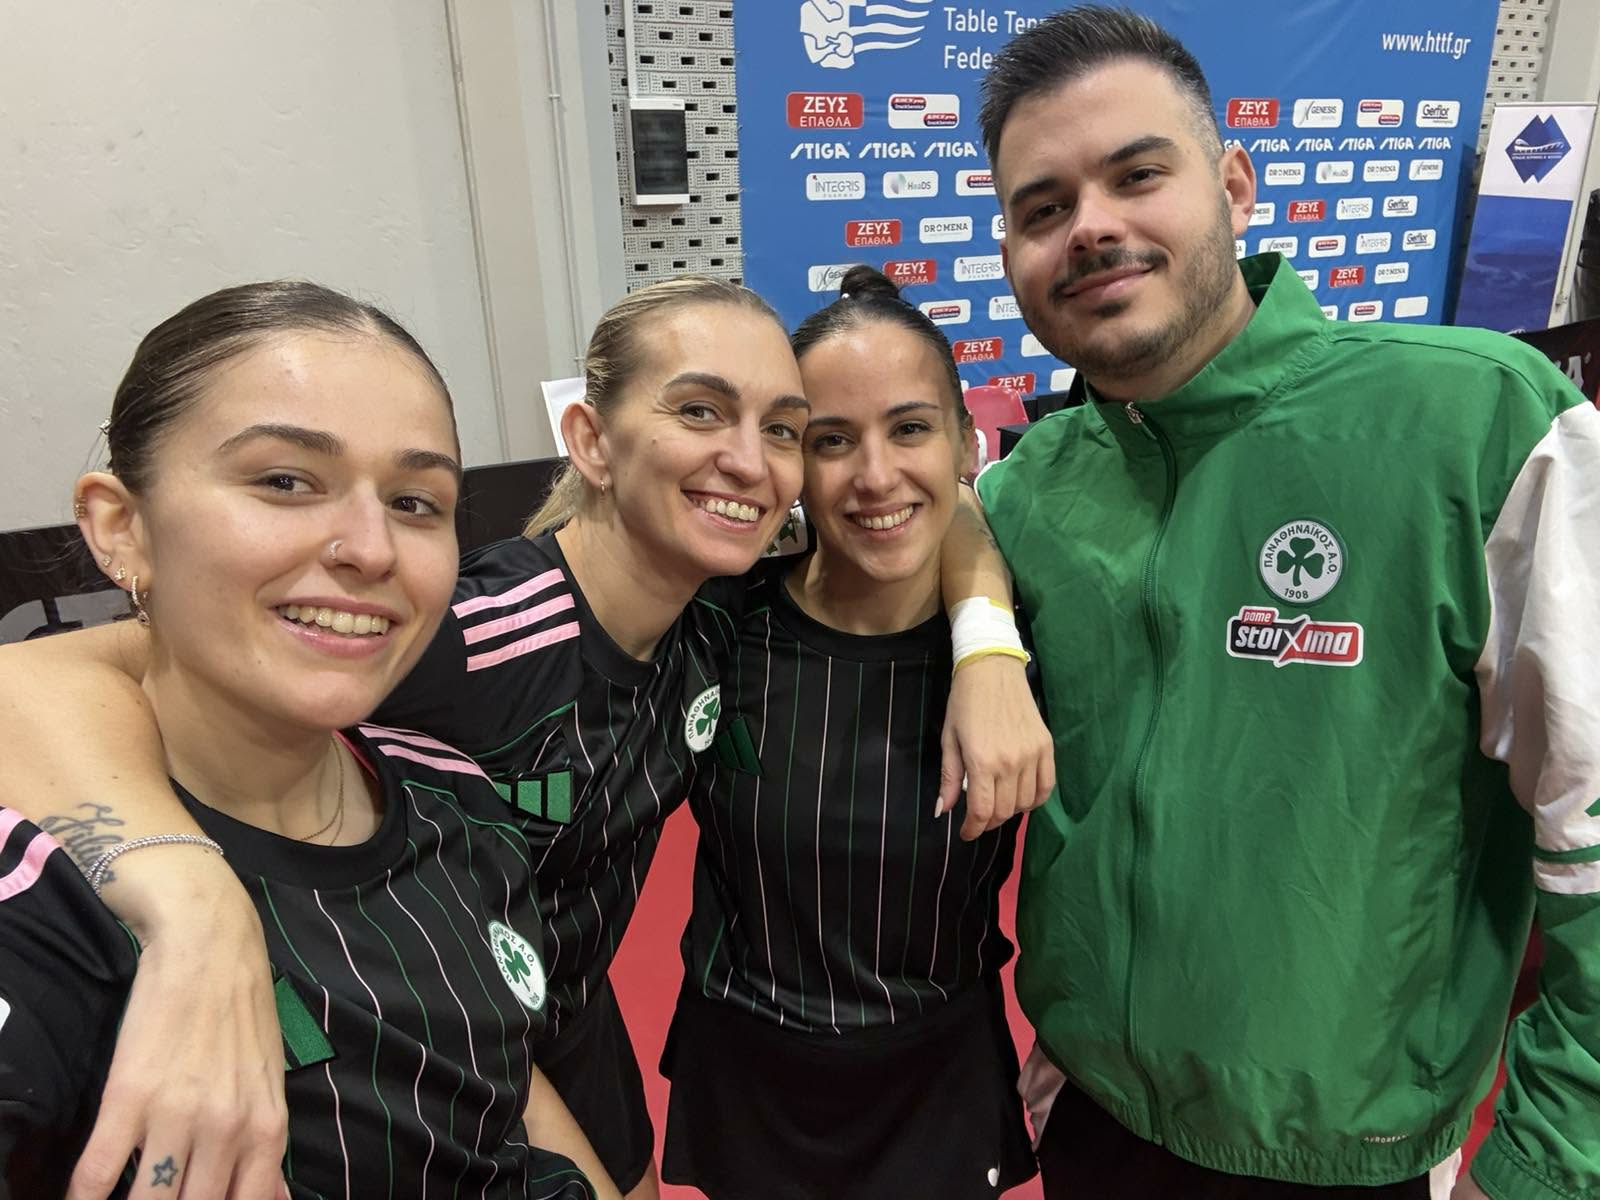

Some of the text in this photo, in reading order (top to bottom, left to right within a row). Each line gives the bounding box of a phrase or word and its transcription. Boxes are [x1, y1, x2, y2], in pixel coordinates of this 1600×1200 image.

[944, 7, 1040, 34] Table Ten
[1382, 31, 1471, 60] www.httf.gr
[944, 45, 993, 70] Fede
[803, 96, 848, 113] ΖΕΥΣ
[1238, 101, 1270, 115] ΖΕΥΣ
[800, 115, 851, 127] ΕΠΑΘΛΑ
[790, 141, 978, 159] STIGA STIGA STIGA
[1250, 138, 1290, 153] STIGA
[1295, 138, 1333, 152] STIGA
[1339, 137, 1375, 151] STIGA
[1380, 137, 1414, 150] STIGA
[1418, 137, 1451, 150] STIGA
[815, 180, 860, 193] INTEGRIS
[857, 222, 891, 235] ΖΕΥΣ
[894, 262, 927, 275] ΖΕΥΣ
[963, 341, 993, 353] ΖΕΥΣ
[1284, 588, 1309, 599] 1908
